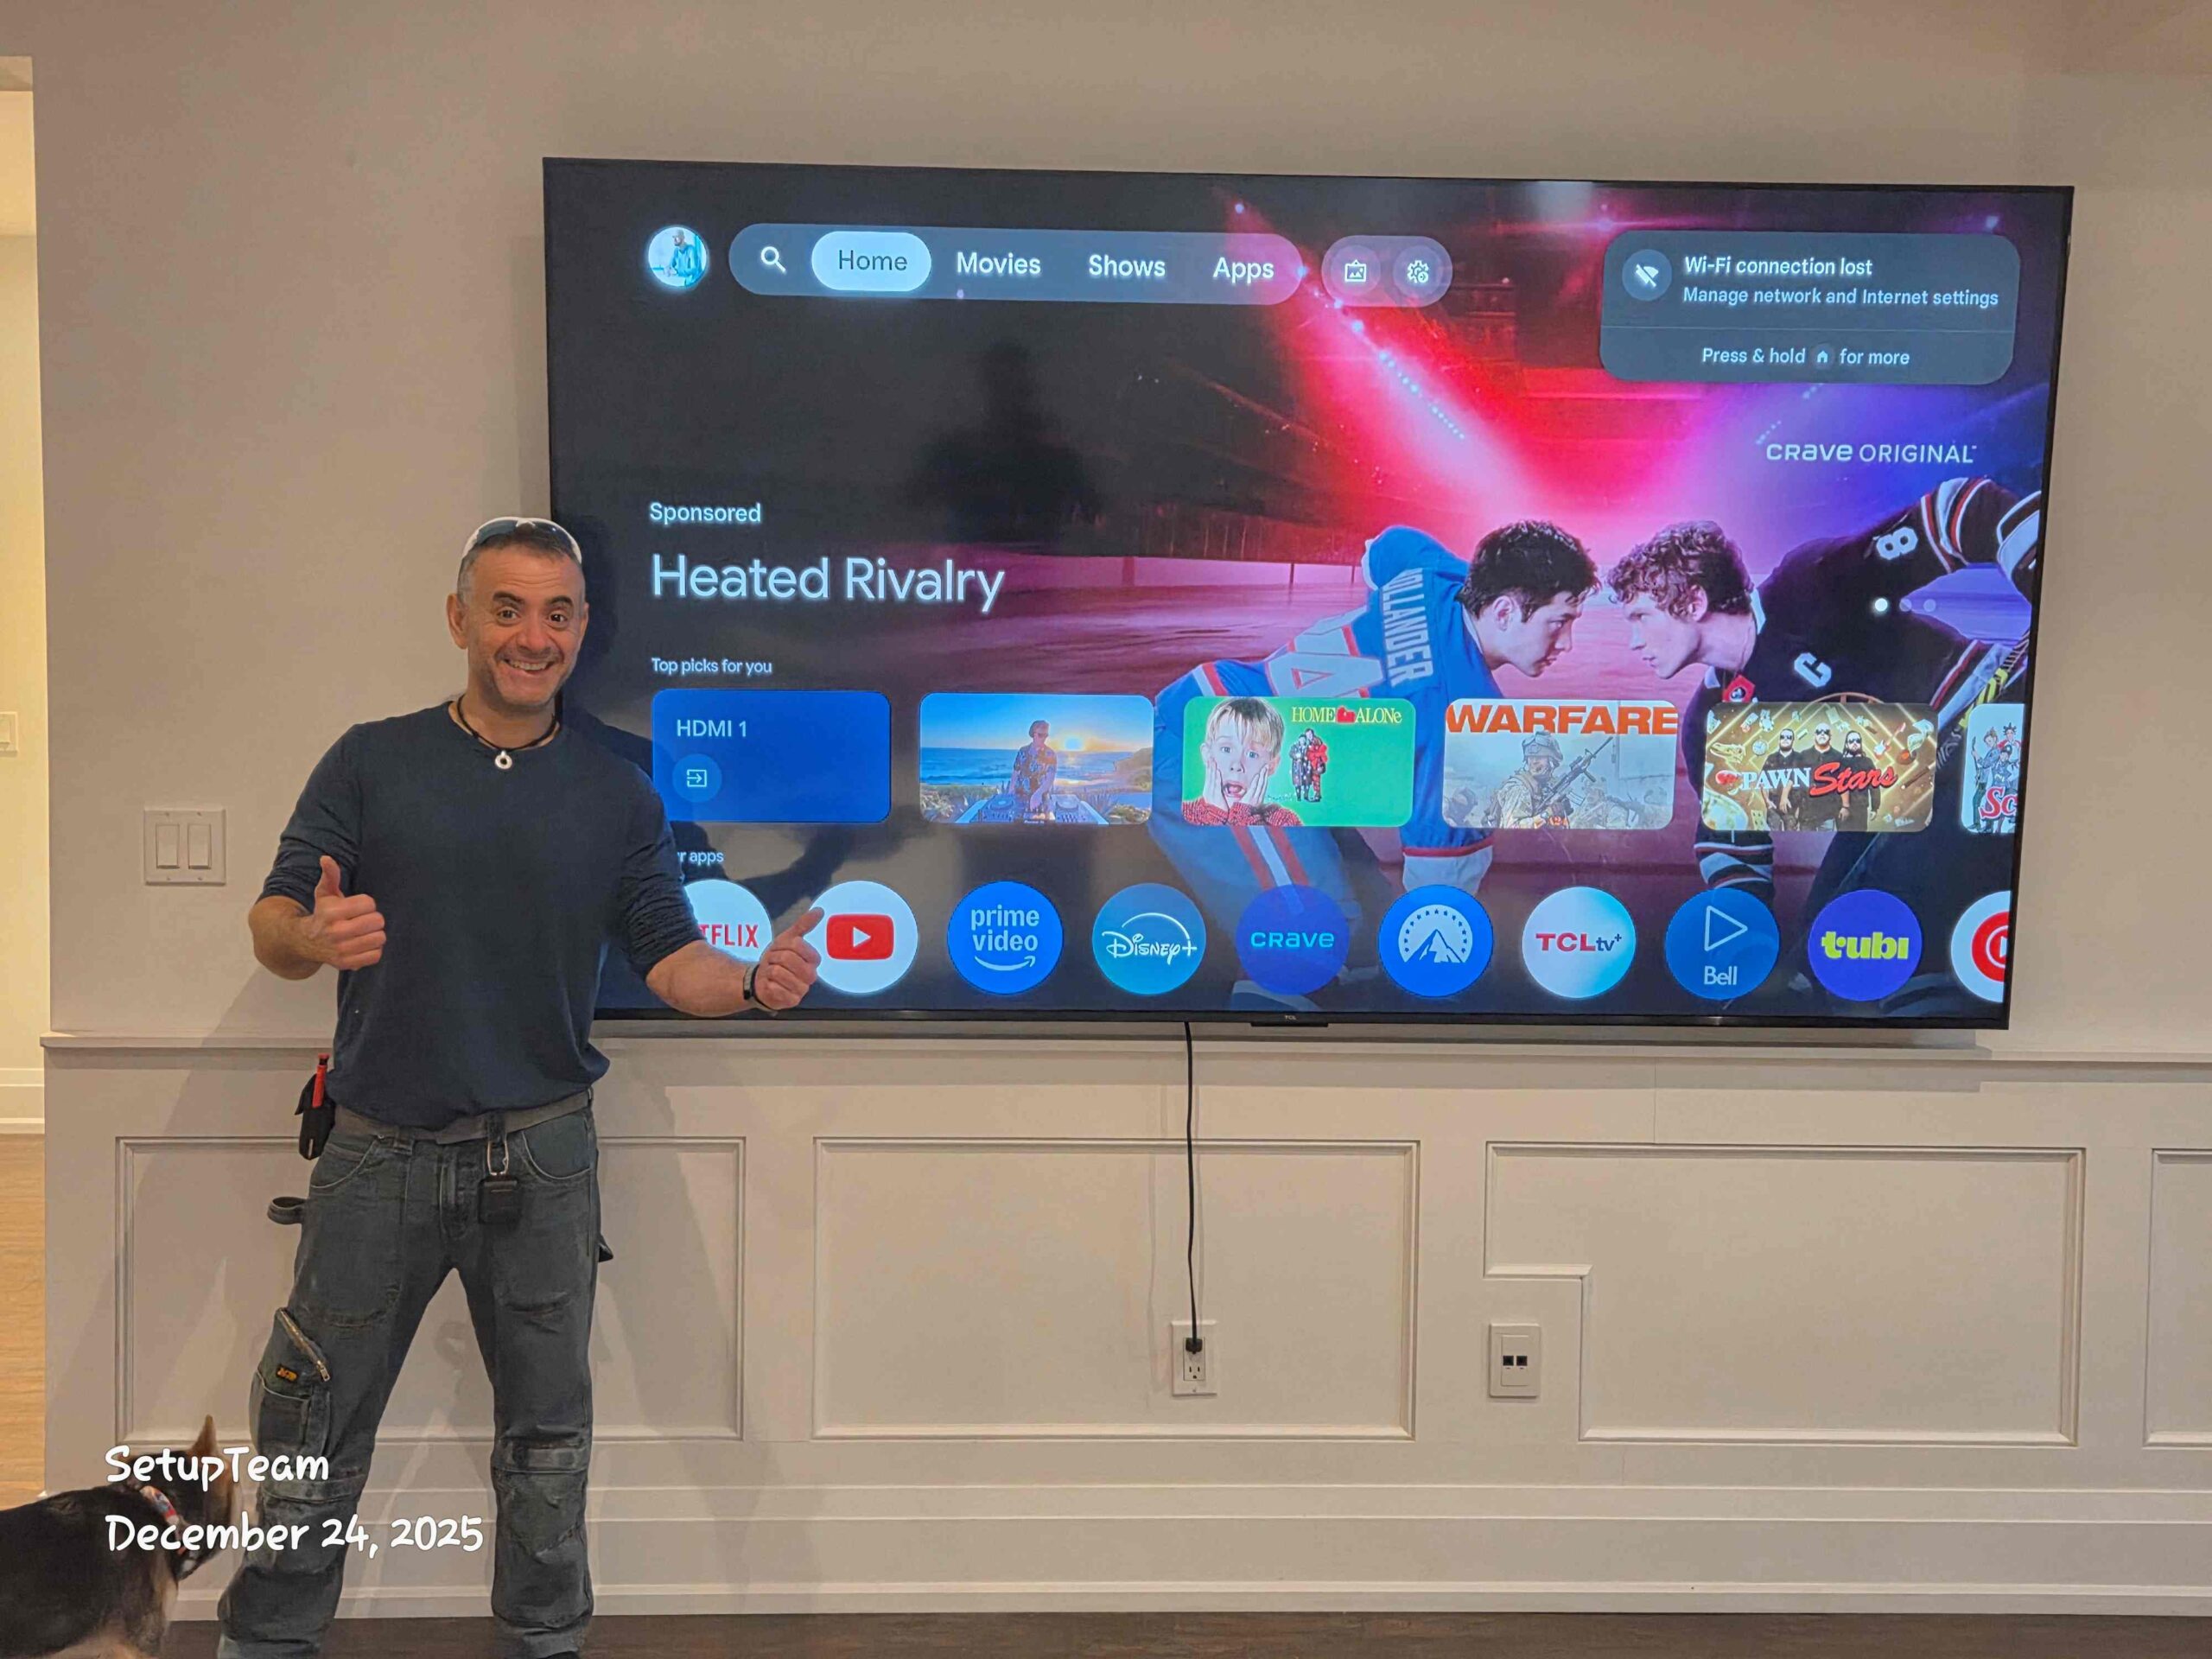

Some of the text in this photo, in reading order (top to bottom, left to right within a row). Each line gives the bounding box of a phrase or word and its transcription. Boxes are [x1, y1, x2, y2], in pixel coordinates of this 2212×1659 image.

[837, 249, 908, 271] Home
[957, 251, 1041, 275] Movies
[1089, 255, 1166, 277] Shows
[1213, 257, 1274, 284] Apps
[1684, 256, 1872, 276] Wi-Fi connection lost
[1683, 287, 1999, 308] Manage network and Internet settings
[1702, 347, 1910, 365] Press & hold for more
[1859, 443, 1974, 464] ORIGINAL
[650, 502, 761, 524] Sponsored
[652, 553, 1005, 613] Heated Rivalry
[652, 657, 772, 677] Top picks for you
[1292, 706, 1336, 723] HOME
[1446, 704, 1678, 734] WARFARE
[677, 719, 747, 737] HDMI 1
[1740, 761, 1897, 797] PAWN Stars
[690, 851, 724, 867] apps
[970, 904, 1040, 931] prime
[697, 923, 760, 949] TFLIX
[972, 927, 1039, 952] video
[1821, 930, 1909, 960] tubi
[1703, 965, 1738, 986] Bell
